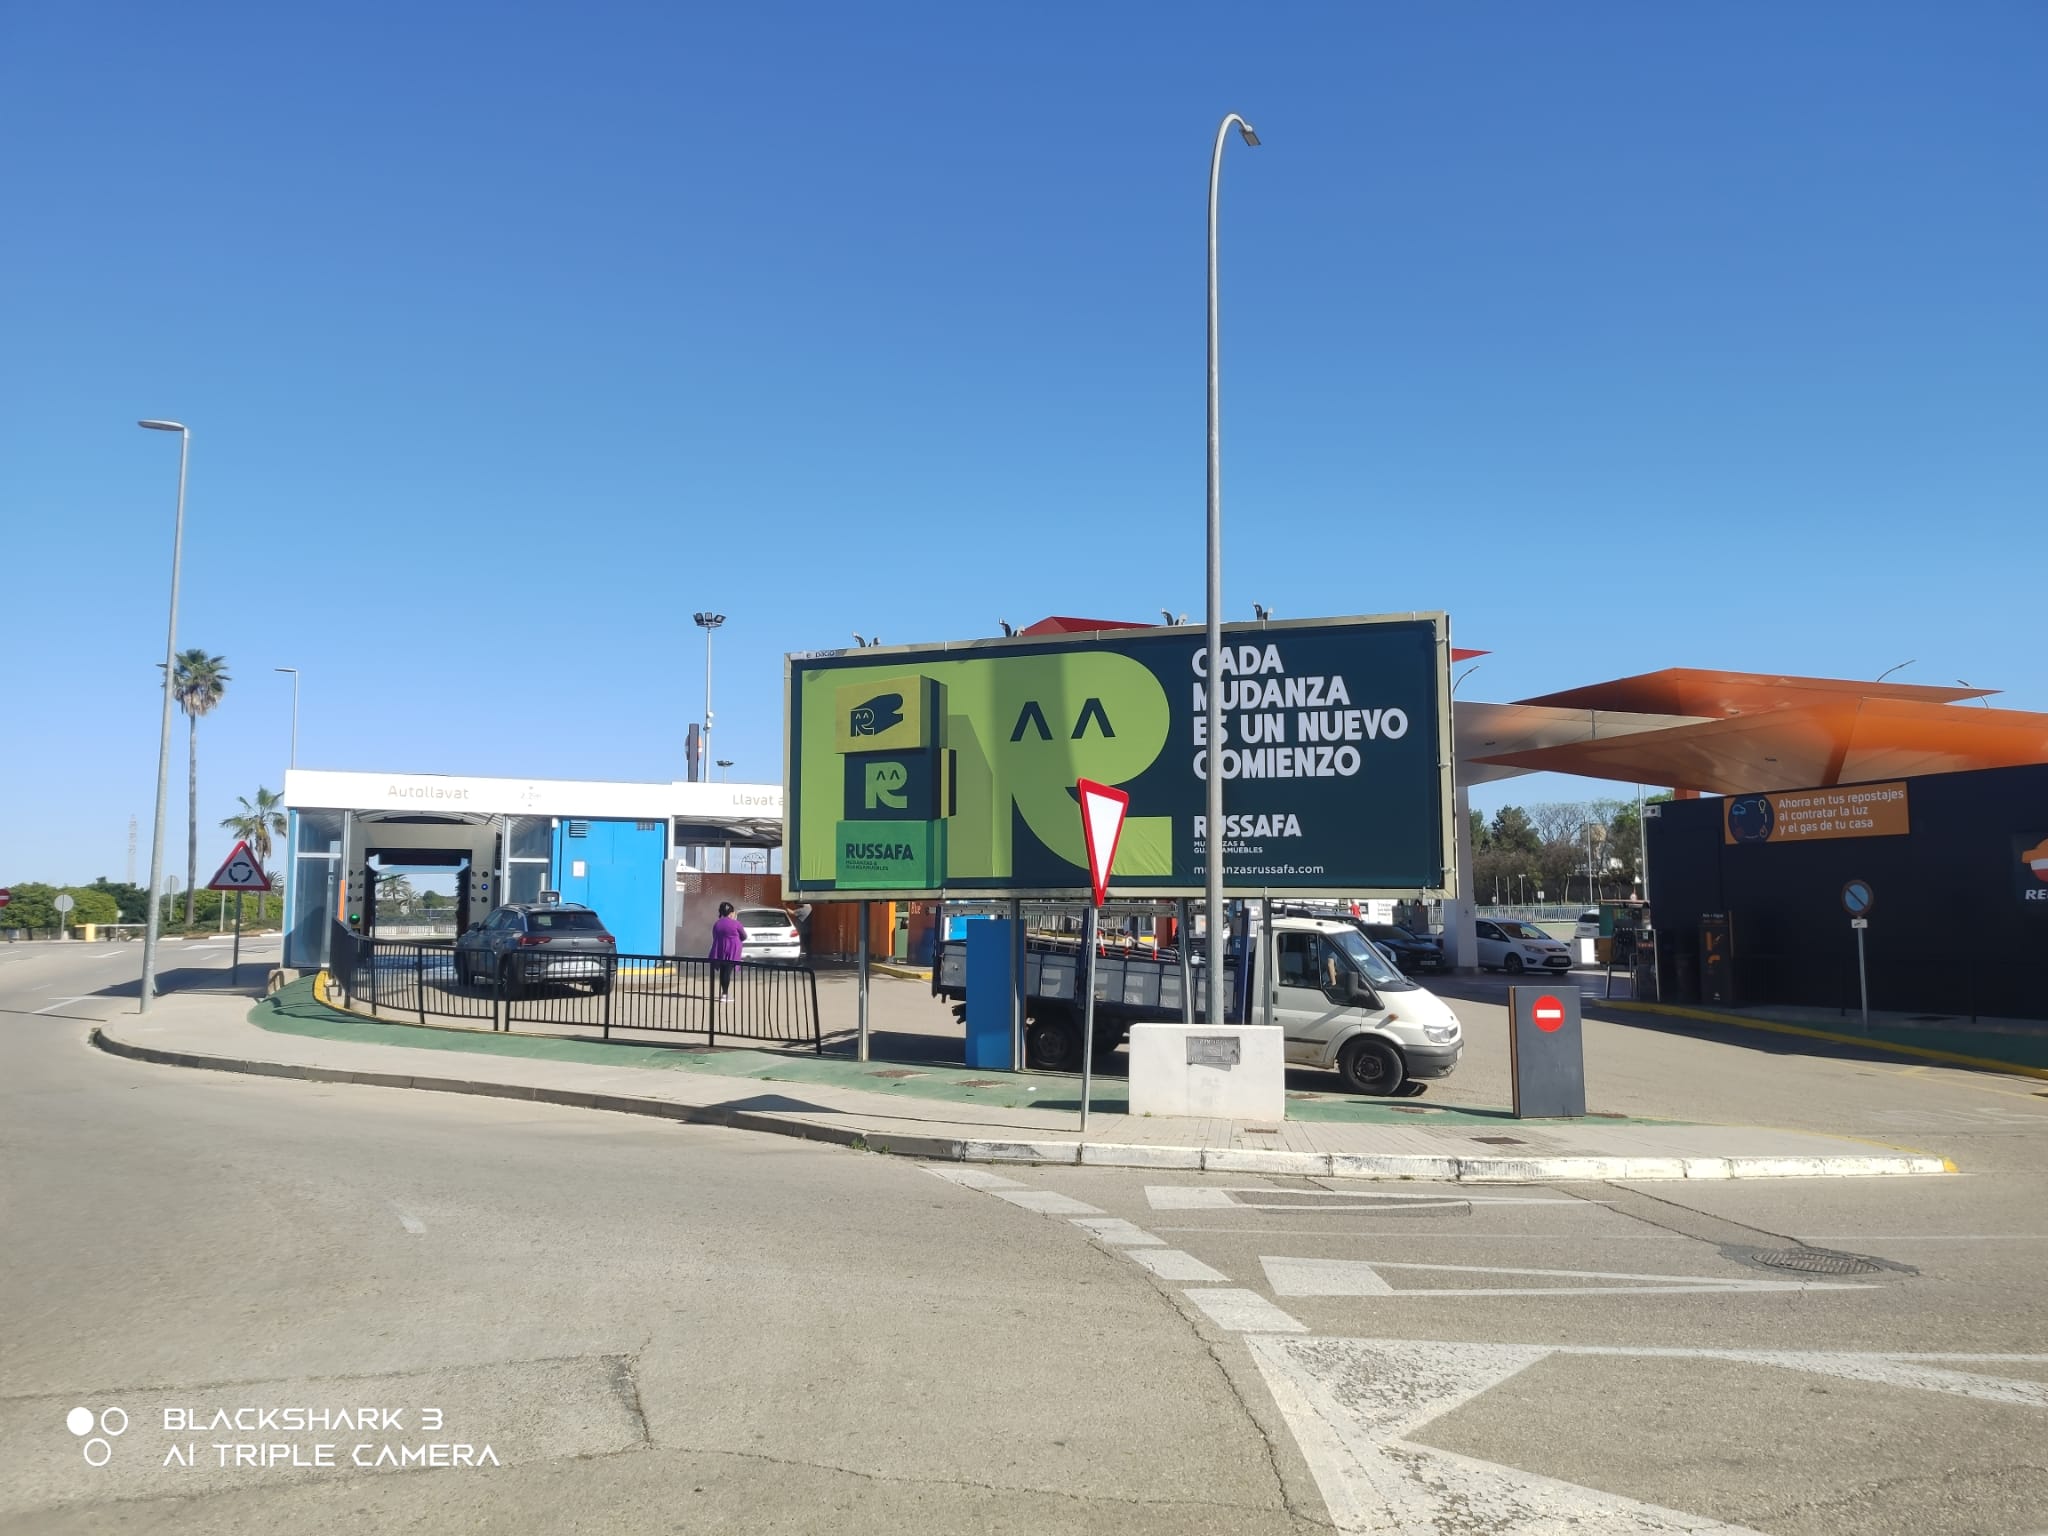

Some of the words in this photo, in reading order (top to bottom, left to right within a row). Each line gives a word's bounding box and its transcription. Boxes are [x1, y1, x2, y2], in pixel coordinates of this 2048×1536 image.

[1191, 644, 1285, 677] CADA
[1193, 675, 1351, 712] MUDANZA
[1240, 712, 1285, 744] UN
[1298, 707, 1409, 742] NUEVO
[1192, 745, 1361, 780] COMIENZO
[387, 785, 470, 800] Autollavat
[732, 793, 774, 806] Llavat
[1778, 797, 1811, 809] Ahorra
[1813, 796, 1826, 807] en
[1828, 793, 1845, 805] tus
[1847, 788, 1905, 804] repostajes
[1779, 811, 1788, 821] al
[1791, 807, 1837, 821] contratar
[1839, 806, 1850, 817] la
[1852, 804, 1869, 815] luz
[1193, 813, 1303, 839] RSSAFA
[1779, 825, 1786, 836] y
[1788, 823, 1797, 833] el
[1800, 823, 1818, 835] gas
[1820, 820, 1832, 831] de
[1835, 819, 1846, 830] tu
[1849, 818, 1873, 829] casa
[845, 843, 914, 861] RUSSAFA
